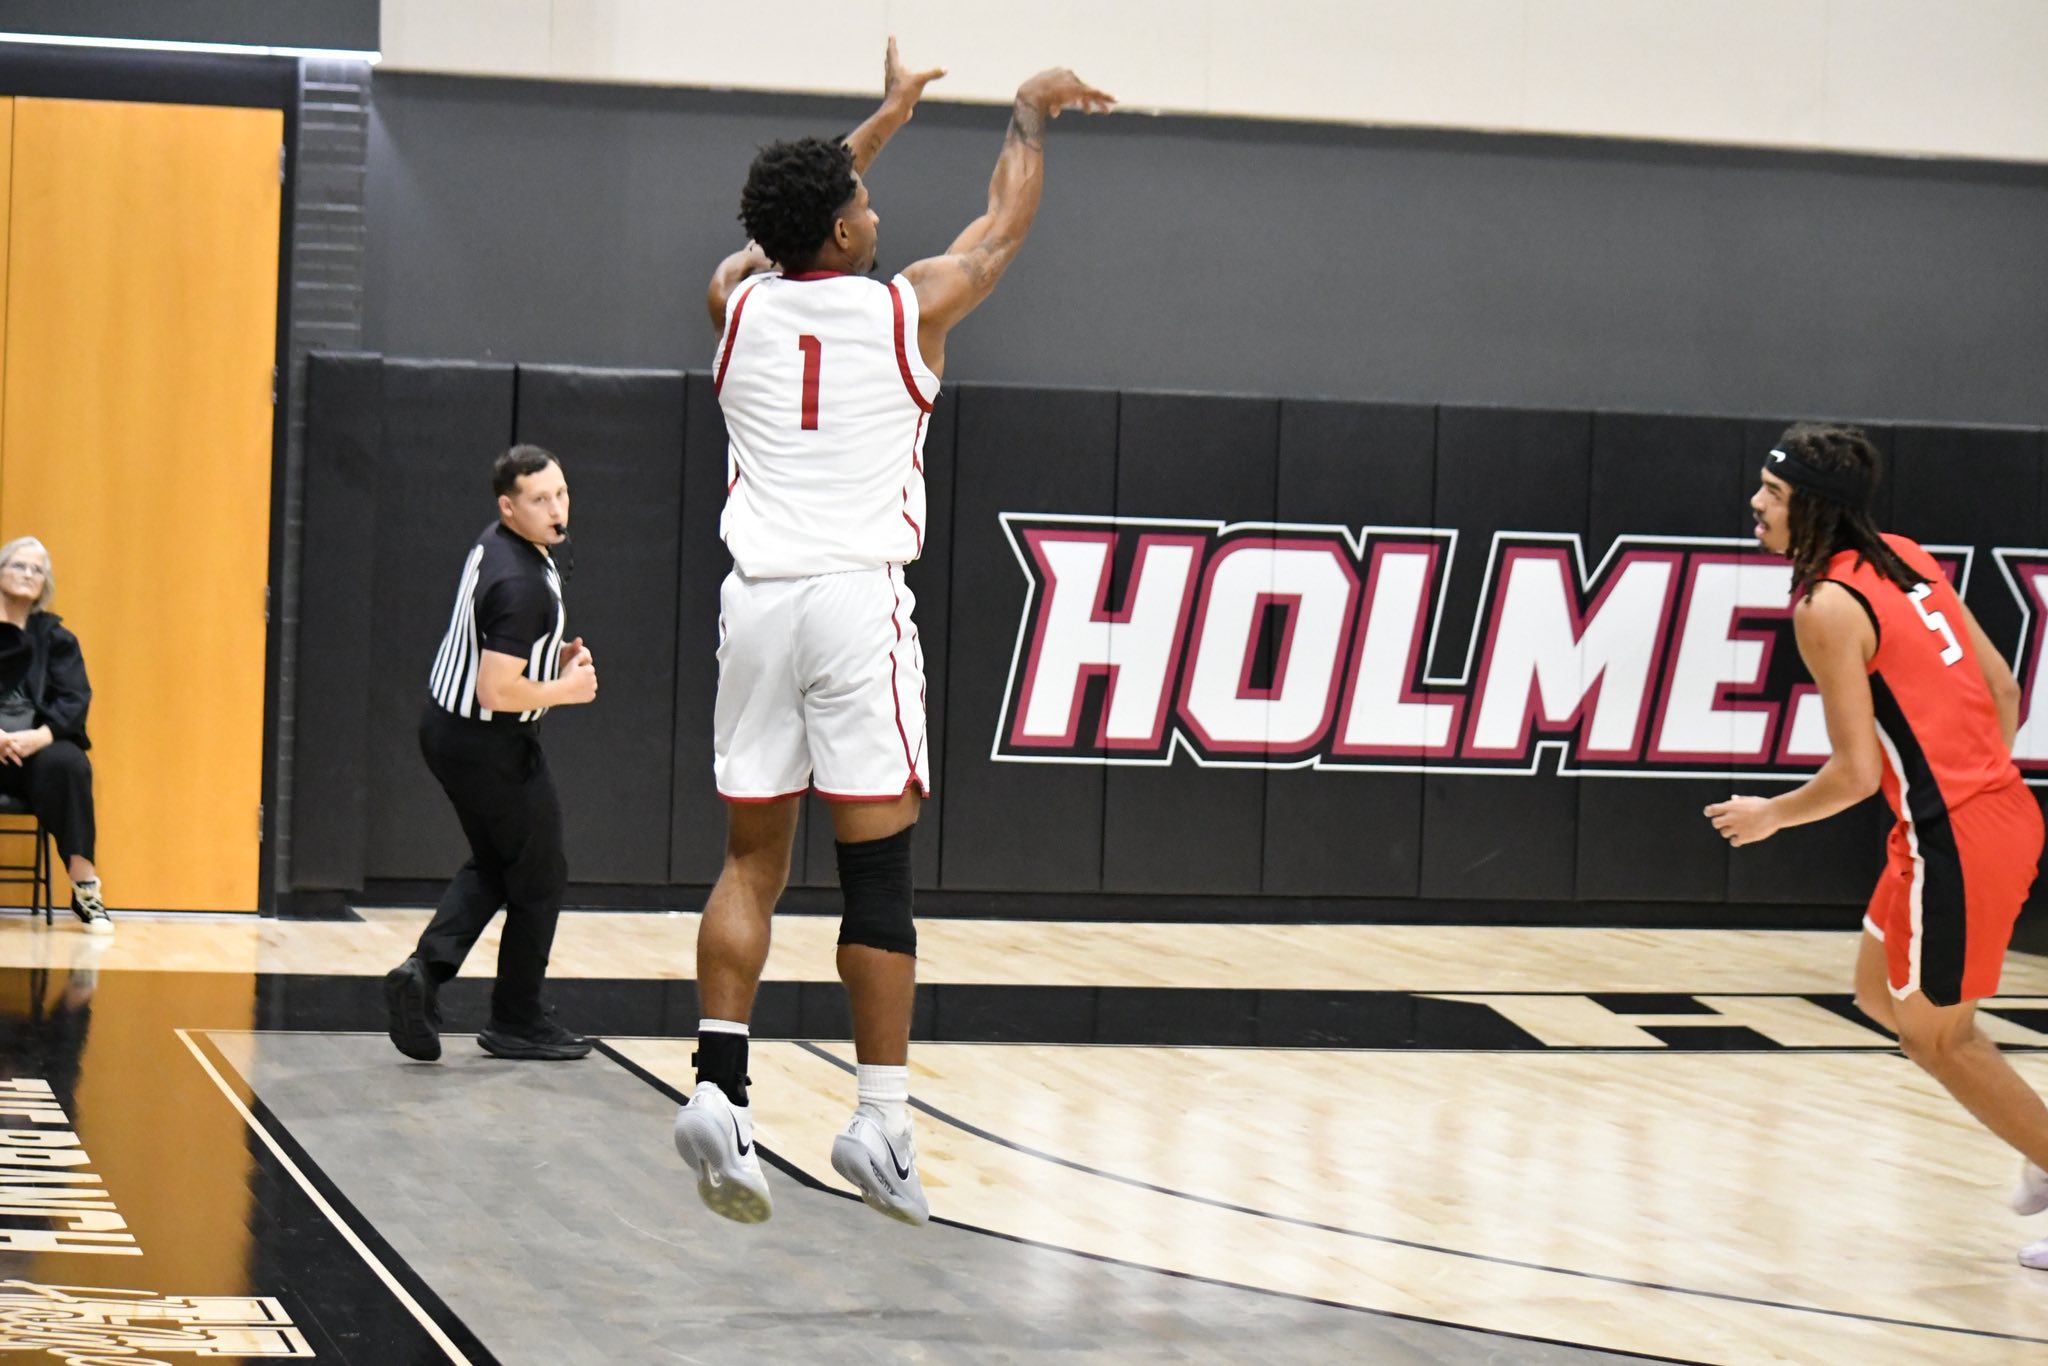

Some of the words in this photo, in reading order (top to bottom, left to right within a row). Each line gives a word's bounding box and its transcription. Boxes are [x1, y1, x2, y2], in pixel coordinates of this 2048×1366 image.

[799, 335, 822, 431] 1
[1006, 526, 1960, 768] HOLME
[1906, 582, 1964, 668] 5
